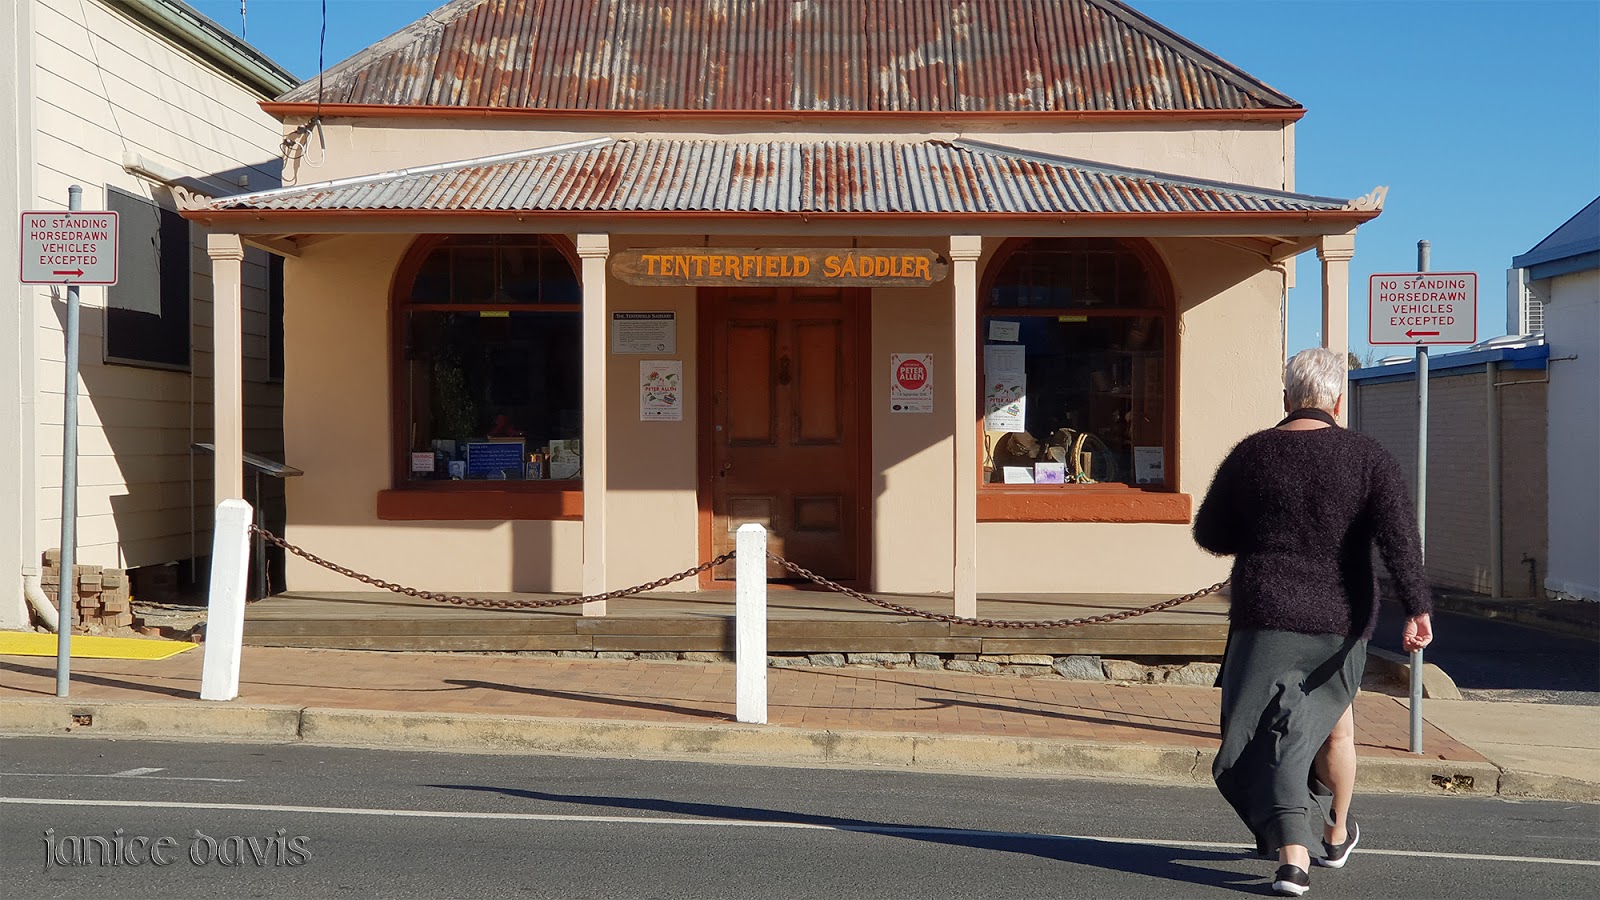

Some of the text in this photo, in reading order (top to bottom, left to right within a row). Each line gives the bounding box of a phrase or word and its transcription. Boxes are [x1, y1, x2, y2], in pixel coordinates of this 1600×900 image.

[31, 219, 108, 229] NO STANDING
[30, 231, 108, 240] HORSEDRAWN
[41, 243, 97, 253] VEHICLES
[39, 255, 98, 265] EXCEPTED
[641, 255, 933, 281] TENTERFIELD SADDLER
[1380, 280, 1466, 290] NO STANDING
[1379, 292, 1466, 302] HORSEDRAWN
[1392, 304, 1454, 314] VEHICLES
[1390, 316, 1455, 326] EXCEPTED
